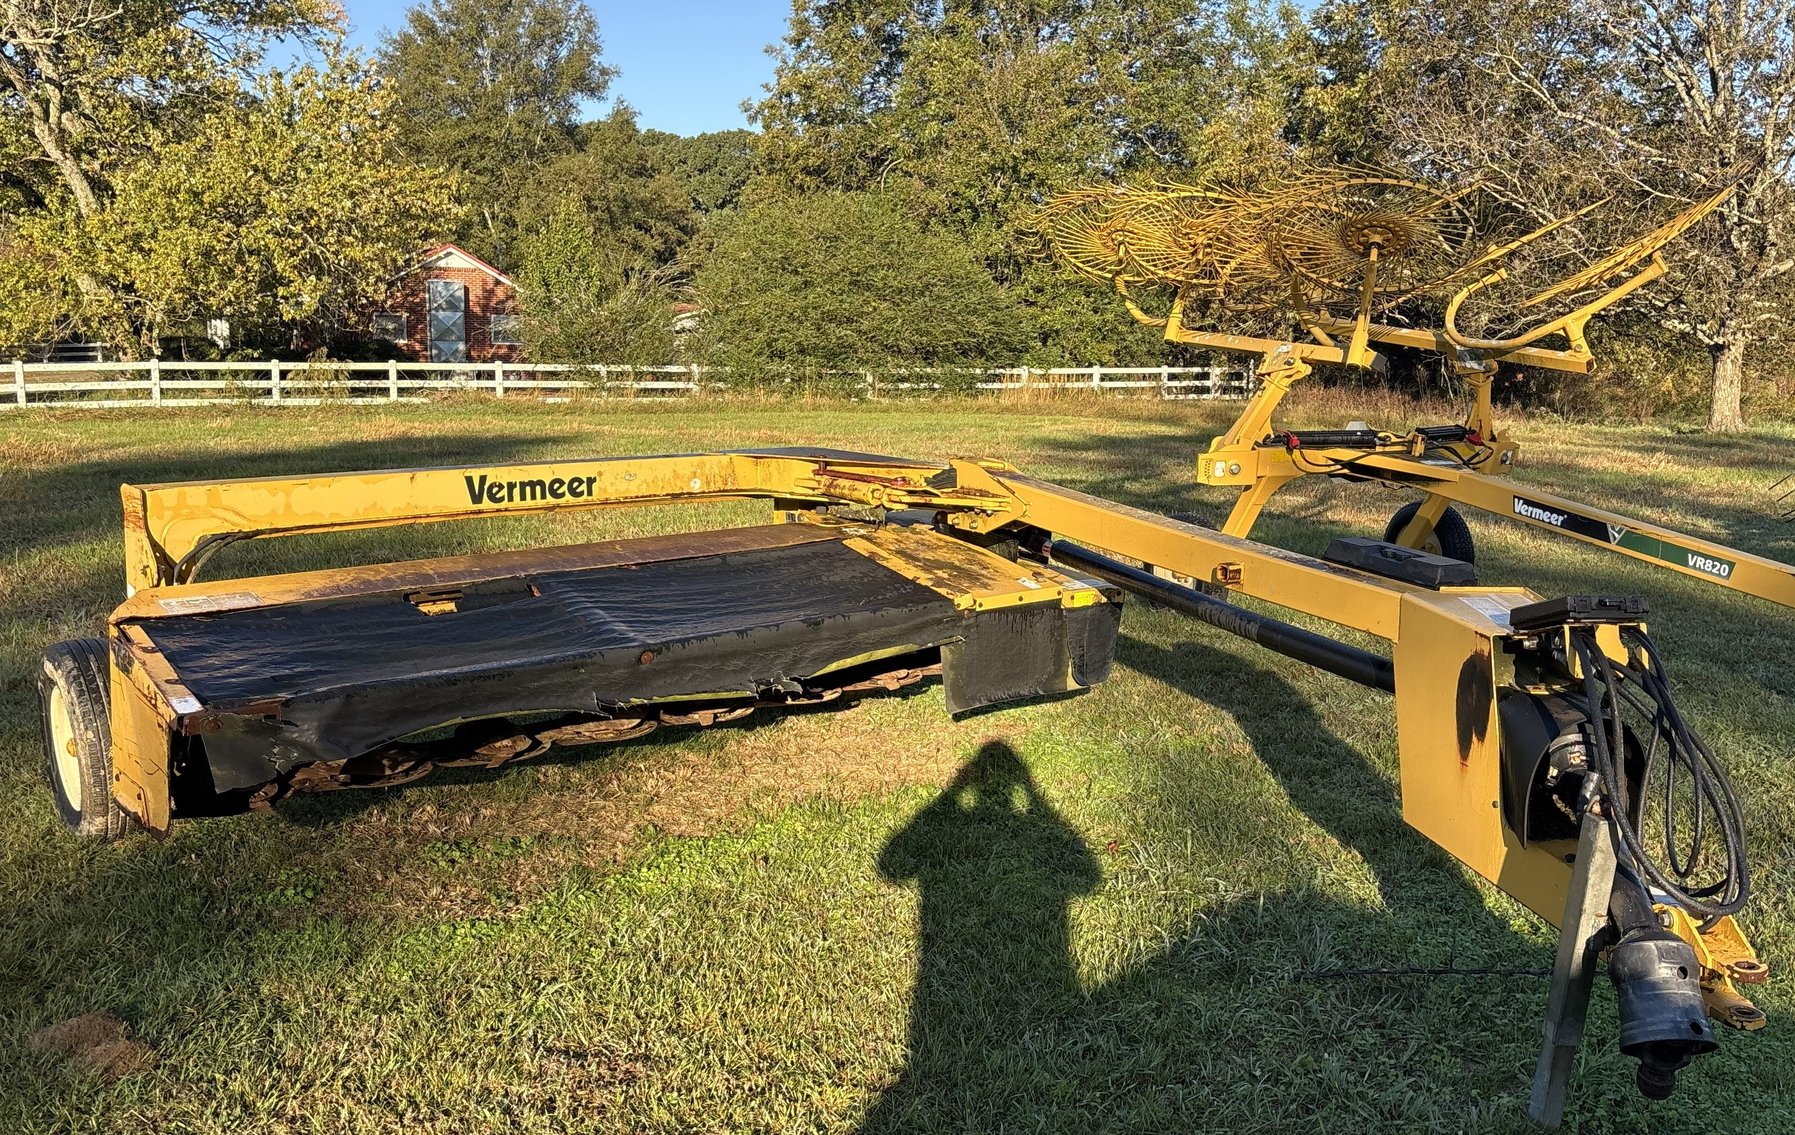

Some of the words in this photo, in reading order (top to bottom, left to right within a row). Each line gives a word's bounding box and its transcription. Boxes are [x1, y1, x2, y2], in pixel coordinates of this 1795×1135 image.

[464, 474, 598, 505] Vermeer
[1514, 498, 1565, 527] Vermeer
[1687, 553, 1729, 577] VR820
